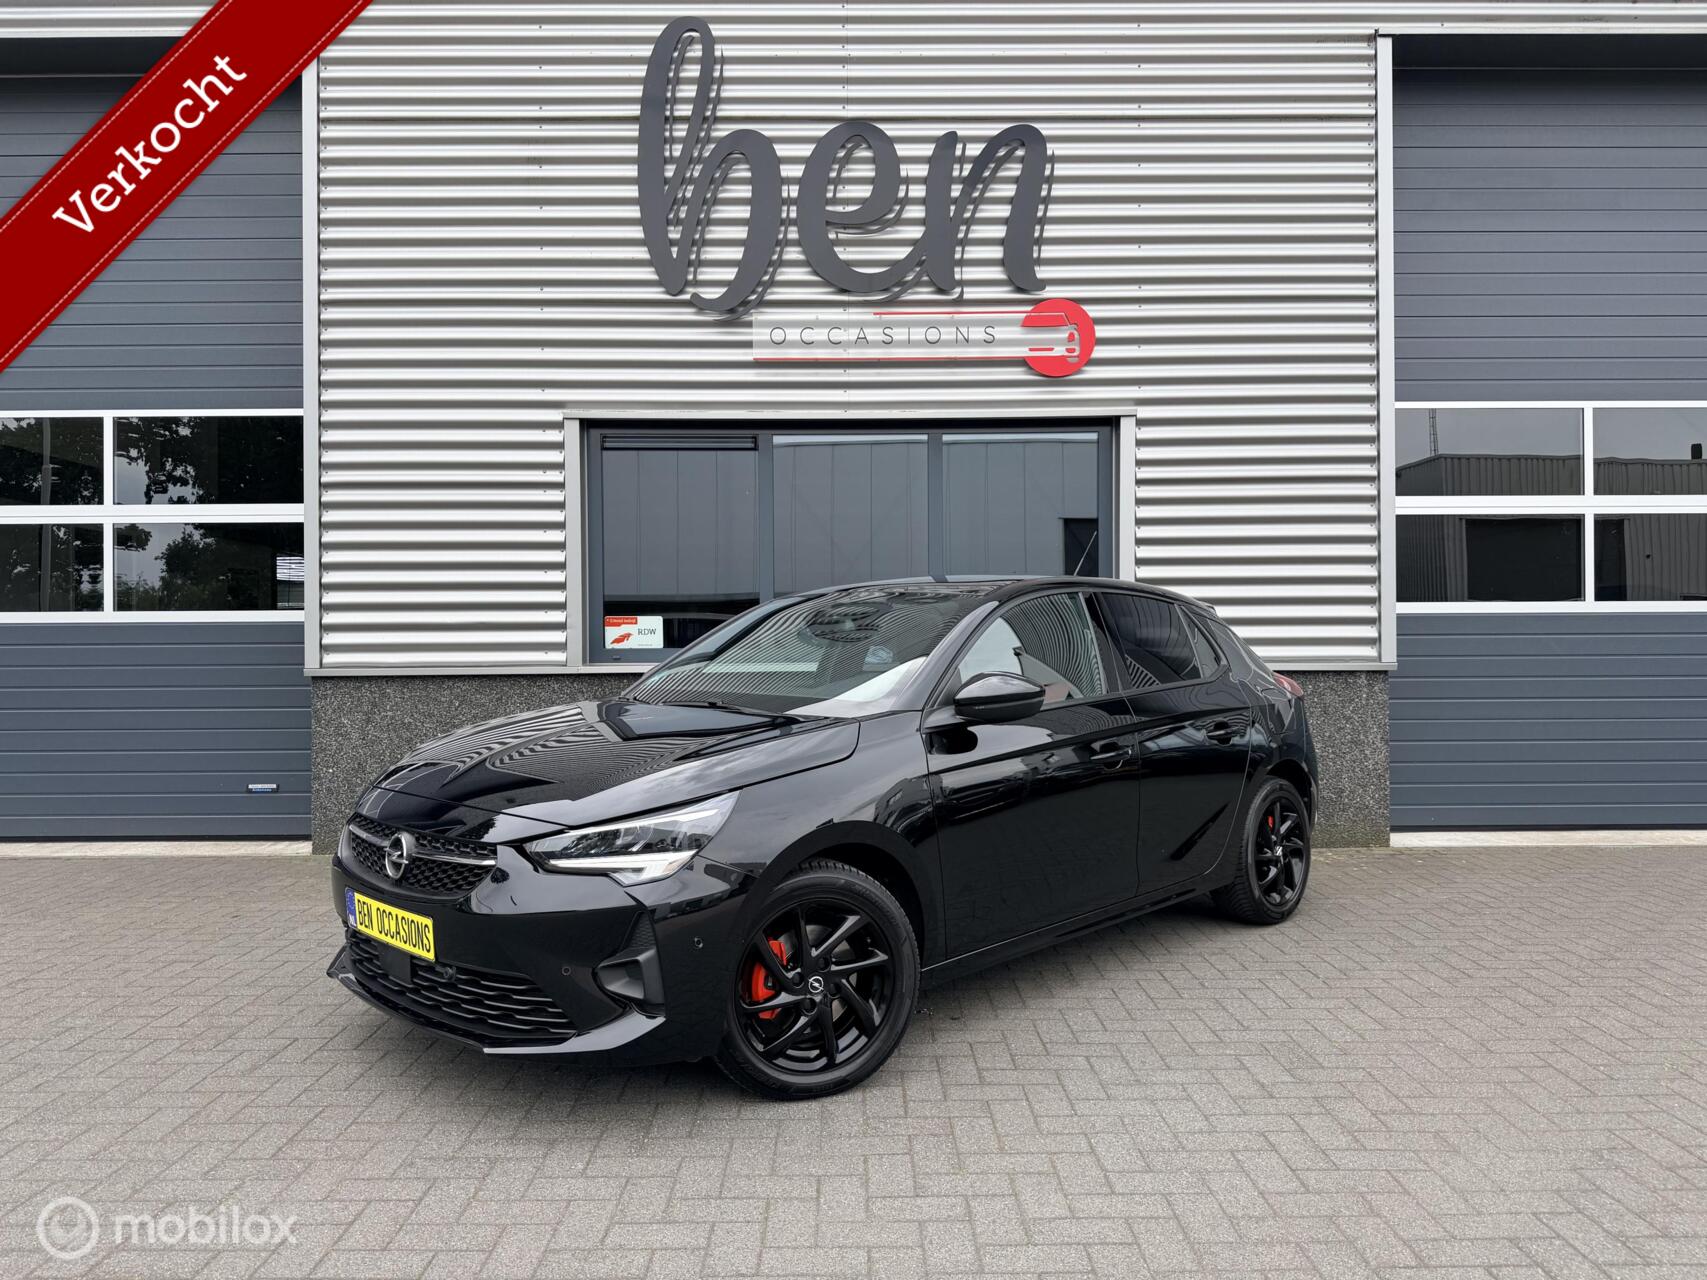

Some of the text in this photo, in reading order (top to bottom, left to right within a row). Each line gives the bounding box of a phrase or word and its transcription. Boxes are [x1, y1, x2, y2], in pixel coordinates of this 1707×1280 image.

[638, 16, 1047, 311] ben
[769, 325, 996, 345] OCCASIONS
[357, 899, 431, 953] BEN OCCASIONS
